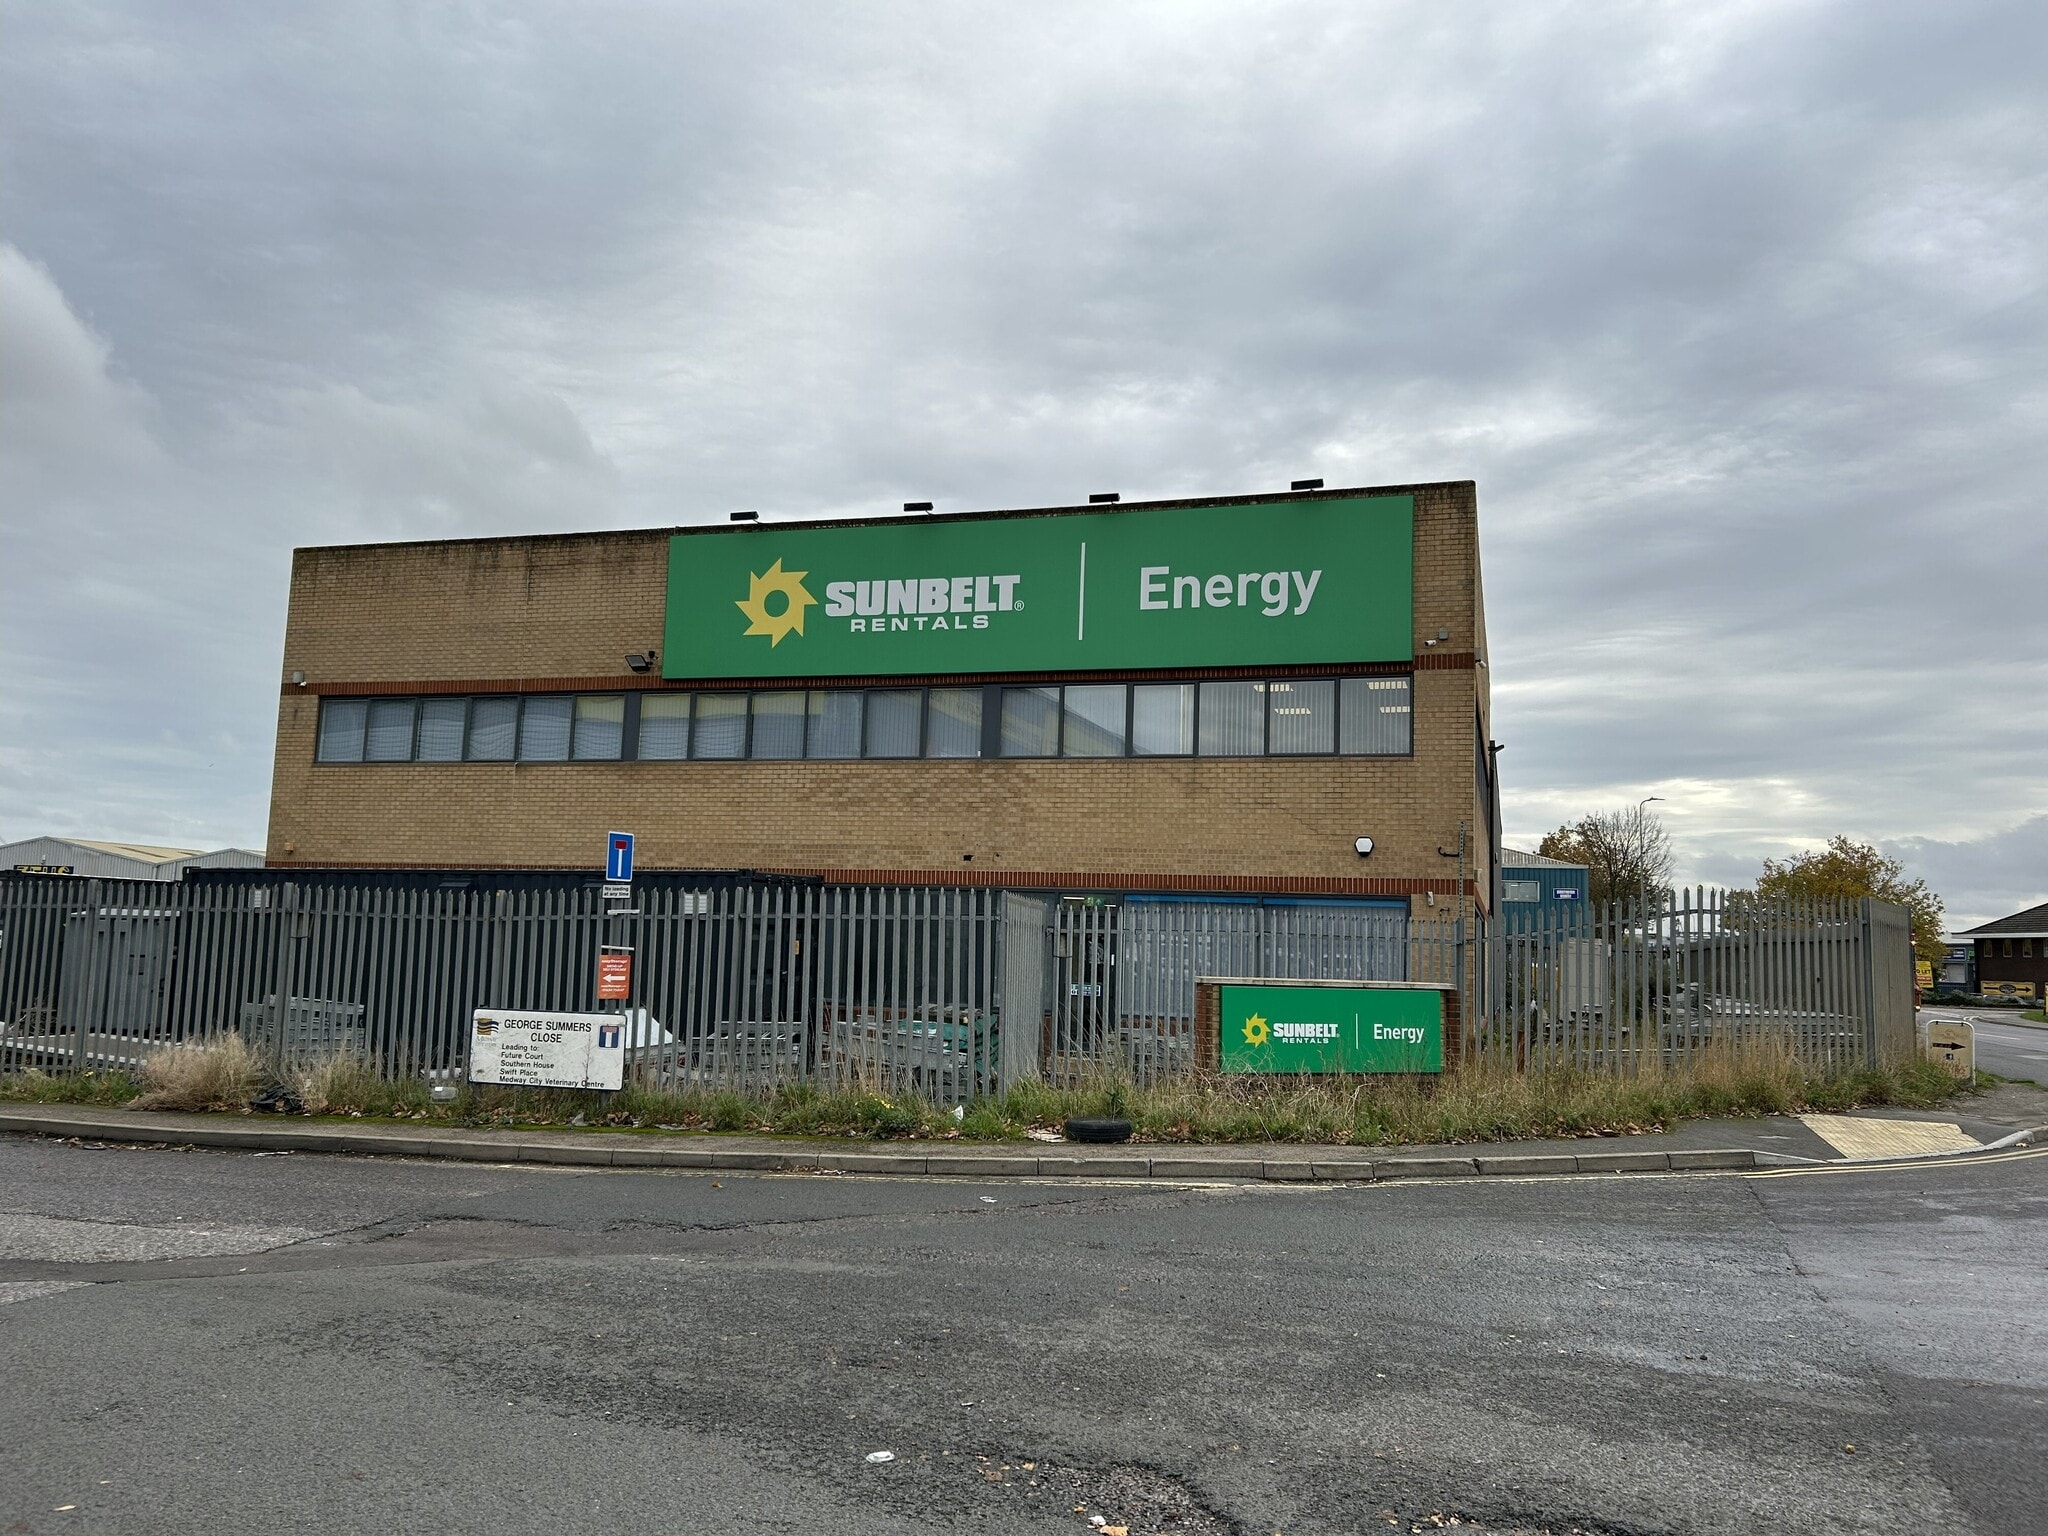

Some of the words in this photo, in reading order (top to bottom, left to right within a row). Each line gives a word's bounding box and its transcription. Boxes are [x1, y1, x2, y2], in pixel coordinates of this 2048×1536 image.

[825, 575, 1020, 617] SUNBELT
[1140, 566, 1322, 617] Energy
[851, 615, 989, 632] RENTALS
[504, 1019, 543, 1030] GEORGE
[545, 1021, 592, 1033] SUMMERS
[1273, 1023, 1338, 1037] SUNBELT
[1374, 1023, 1424, 1043] Energy
[530, 1032, 562, 1043] CLOSE
[502, 1043, 527, 1052] Leading
[499, 1076, 526, 1085] Medway
[529, 1077, 542, 1086] City
[545, 1078, 579, 1087] Veterinary
